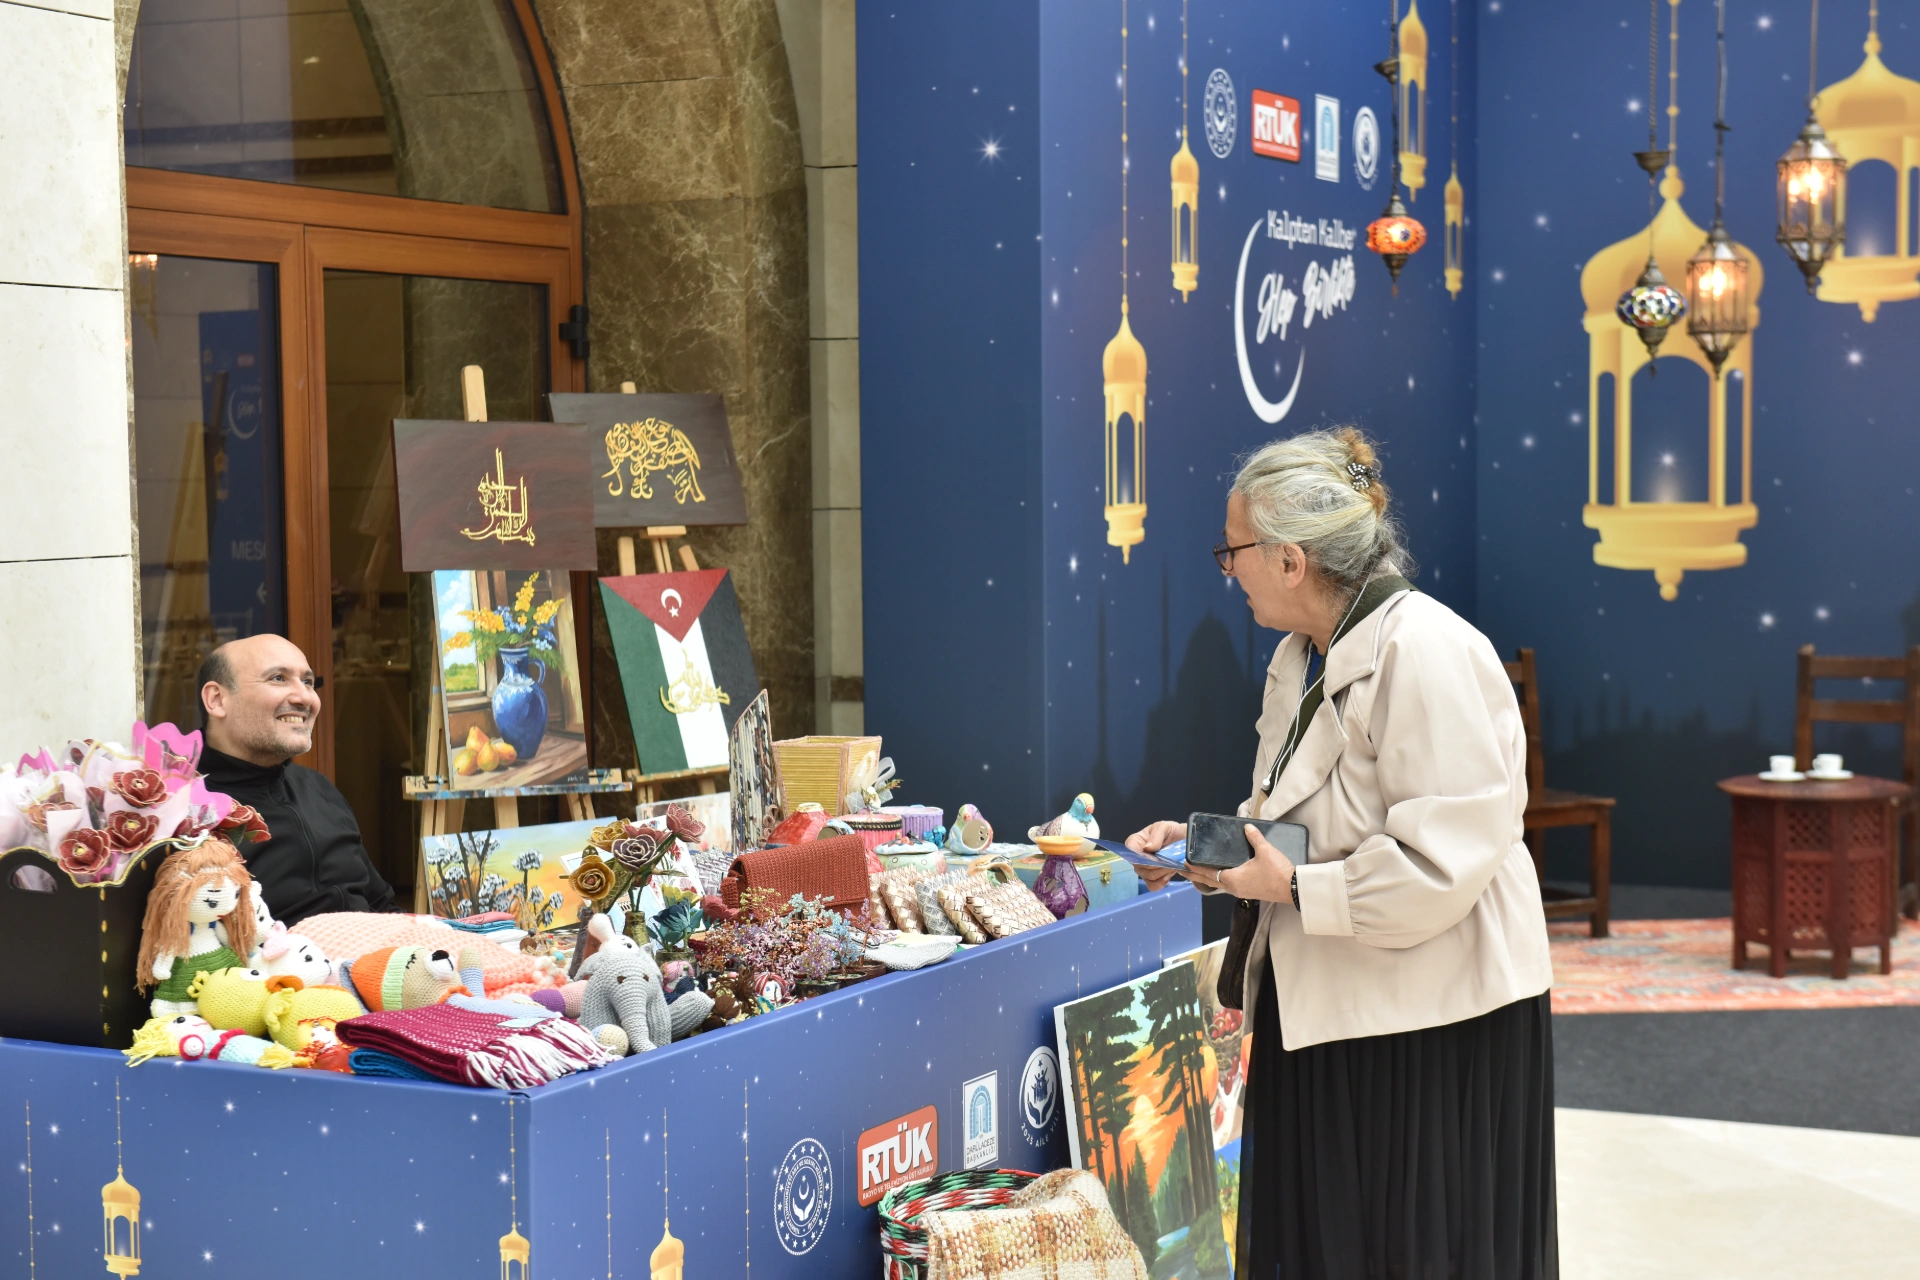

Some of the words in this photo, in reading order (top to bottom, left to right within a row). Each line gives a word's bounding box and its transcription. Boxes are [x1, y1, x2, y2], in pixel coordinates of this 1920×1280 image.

[1253, 99, 1298, 149] RTÜK
[1267, 209, 1317, 250] Kalpten
[231, 539, 266, 562] MES
[1021, 1122, 1034, 1146] 2025
[862, 1121, 932, 1190] RTÜK
